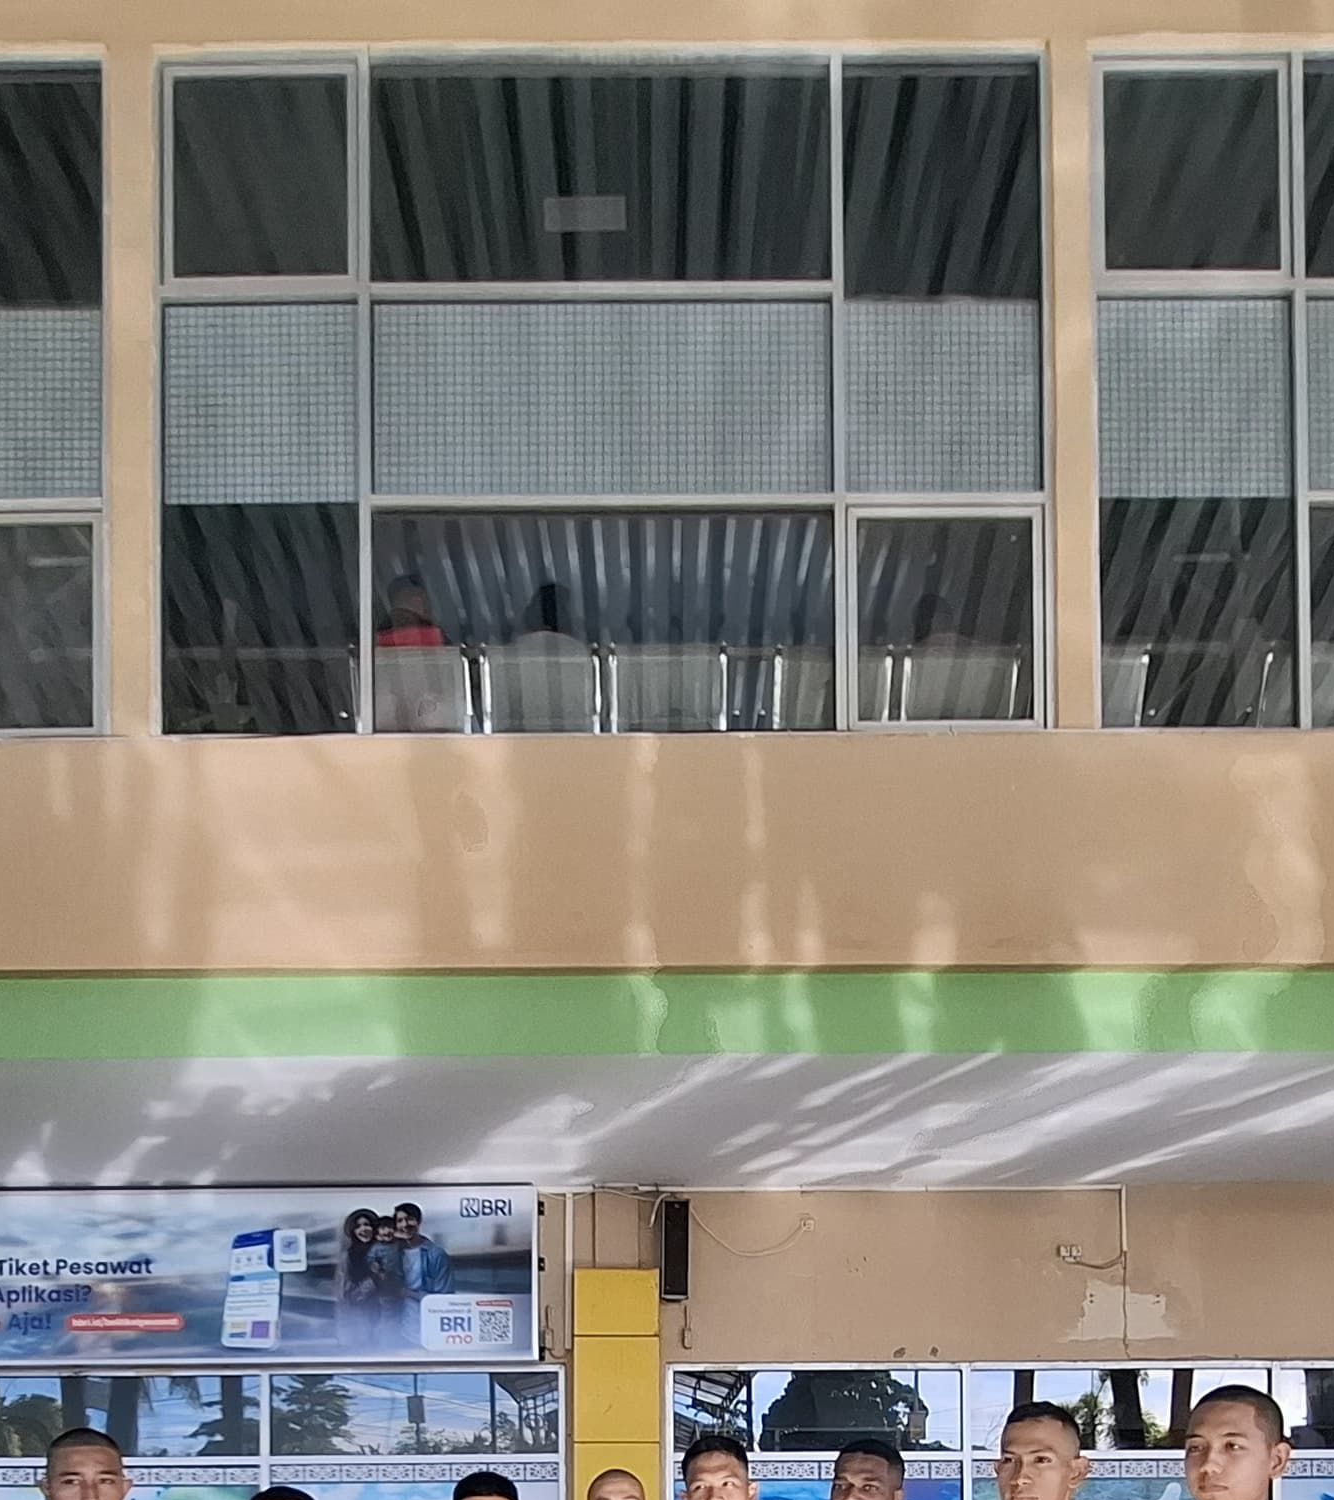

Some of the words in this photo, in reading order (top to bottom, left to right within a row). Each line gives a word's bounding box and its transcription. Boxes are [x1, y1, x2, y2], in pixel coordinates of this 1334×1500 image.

[481, 1200, 513, 1216] BRI
[55, 1257, 153, 1276] Pesawat
[7, 1312, 52, 1332] Aja!
[440, 1316, 472, 1332] BRI
